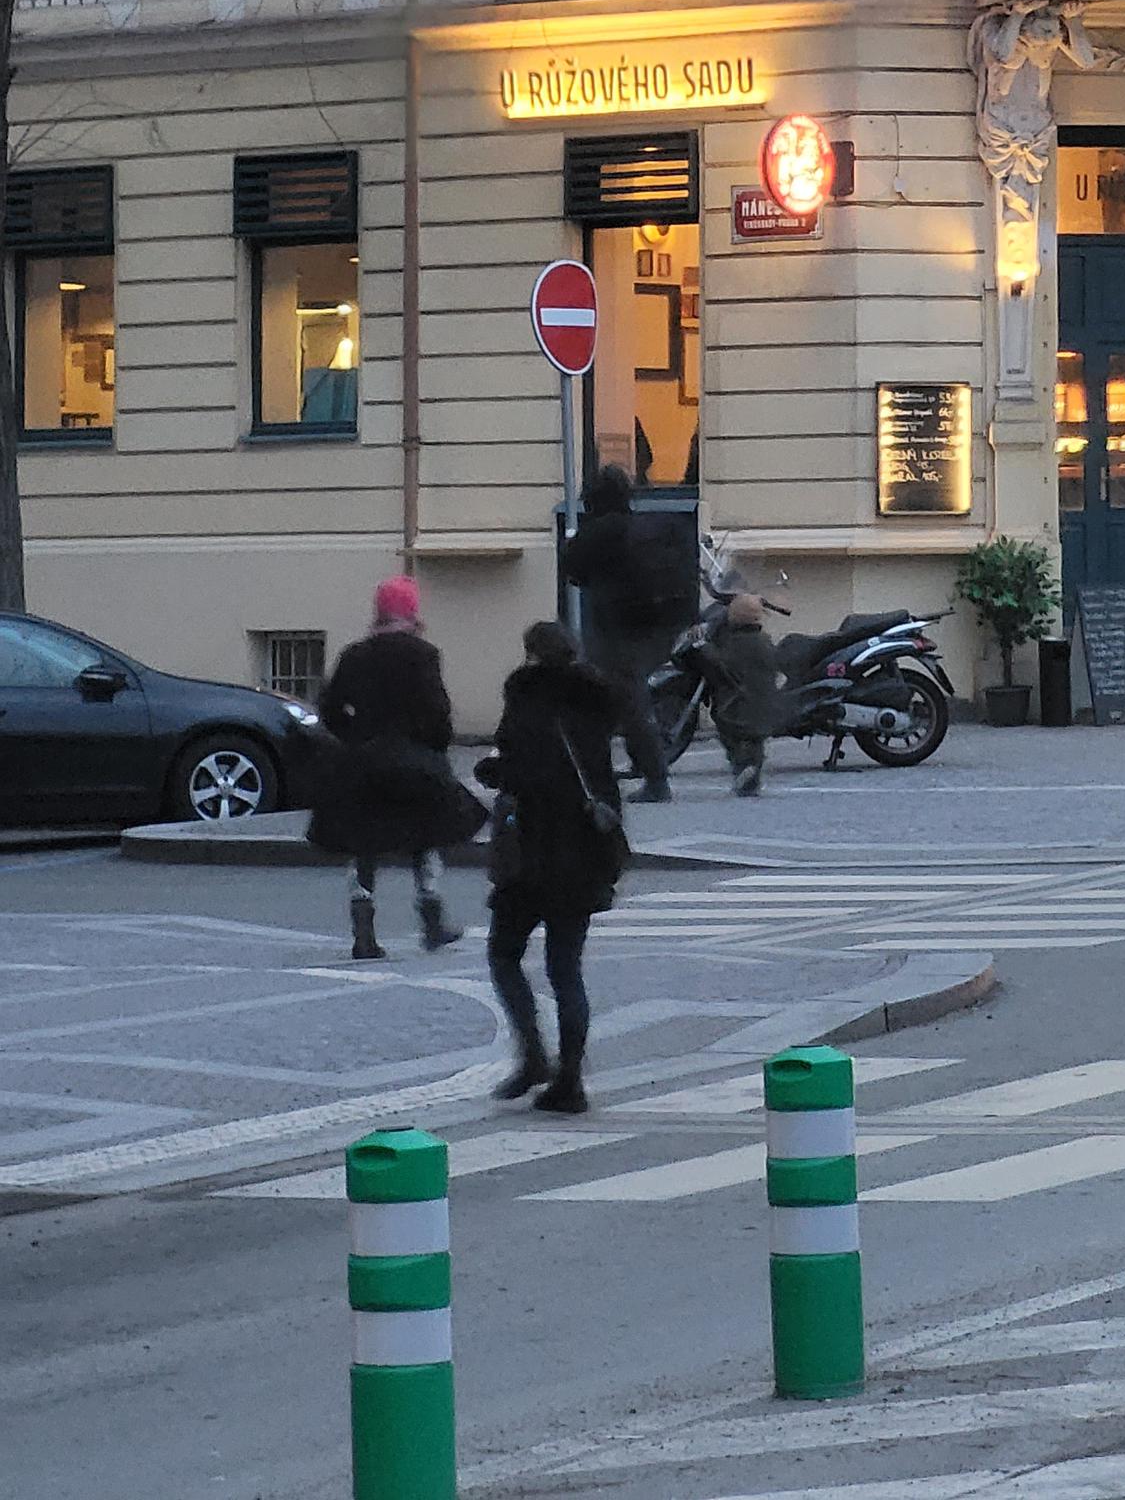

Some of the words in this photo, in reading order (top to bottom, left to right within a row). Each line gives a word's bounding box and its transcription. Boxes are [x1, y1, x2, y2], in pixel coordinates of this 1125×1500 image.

[500, 68, 516, 109] U
[528, 55, 669, 108] RŮŽOVÉHO
[683, 57, 754, 99] SADU
[1076, 174, 1088, 201] U
